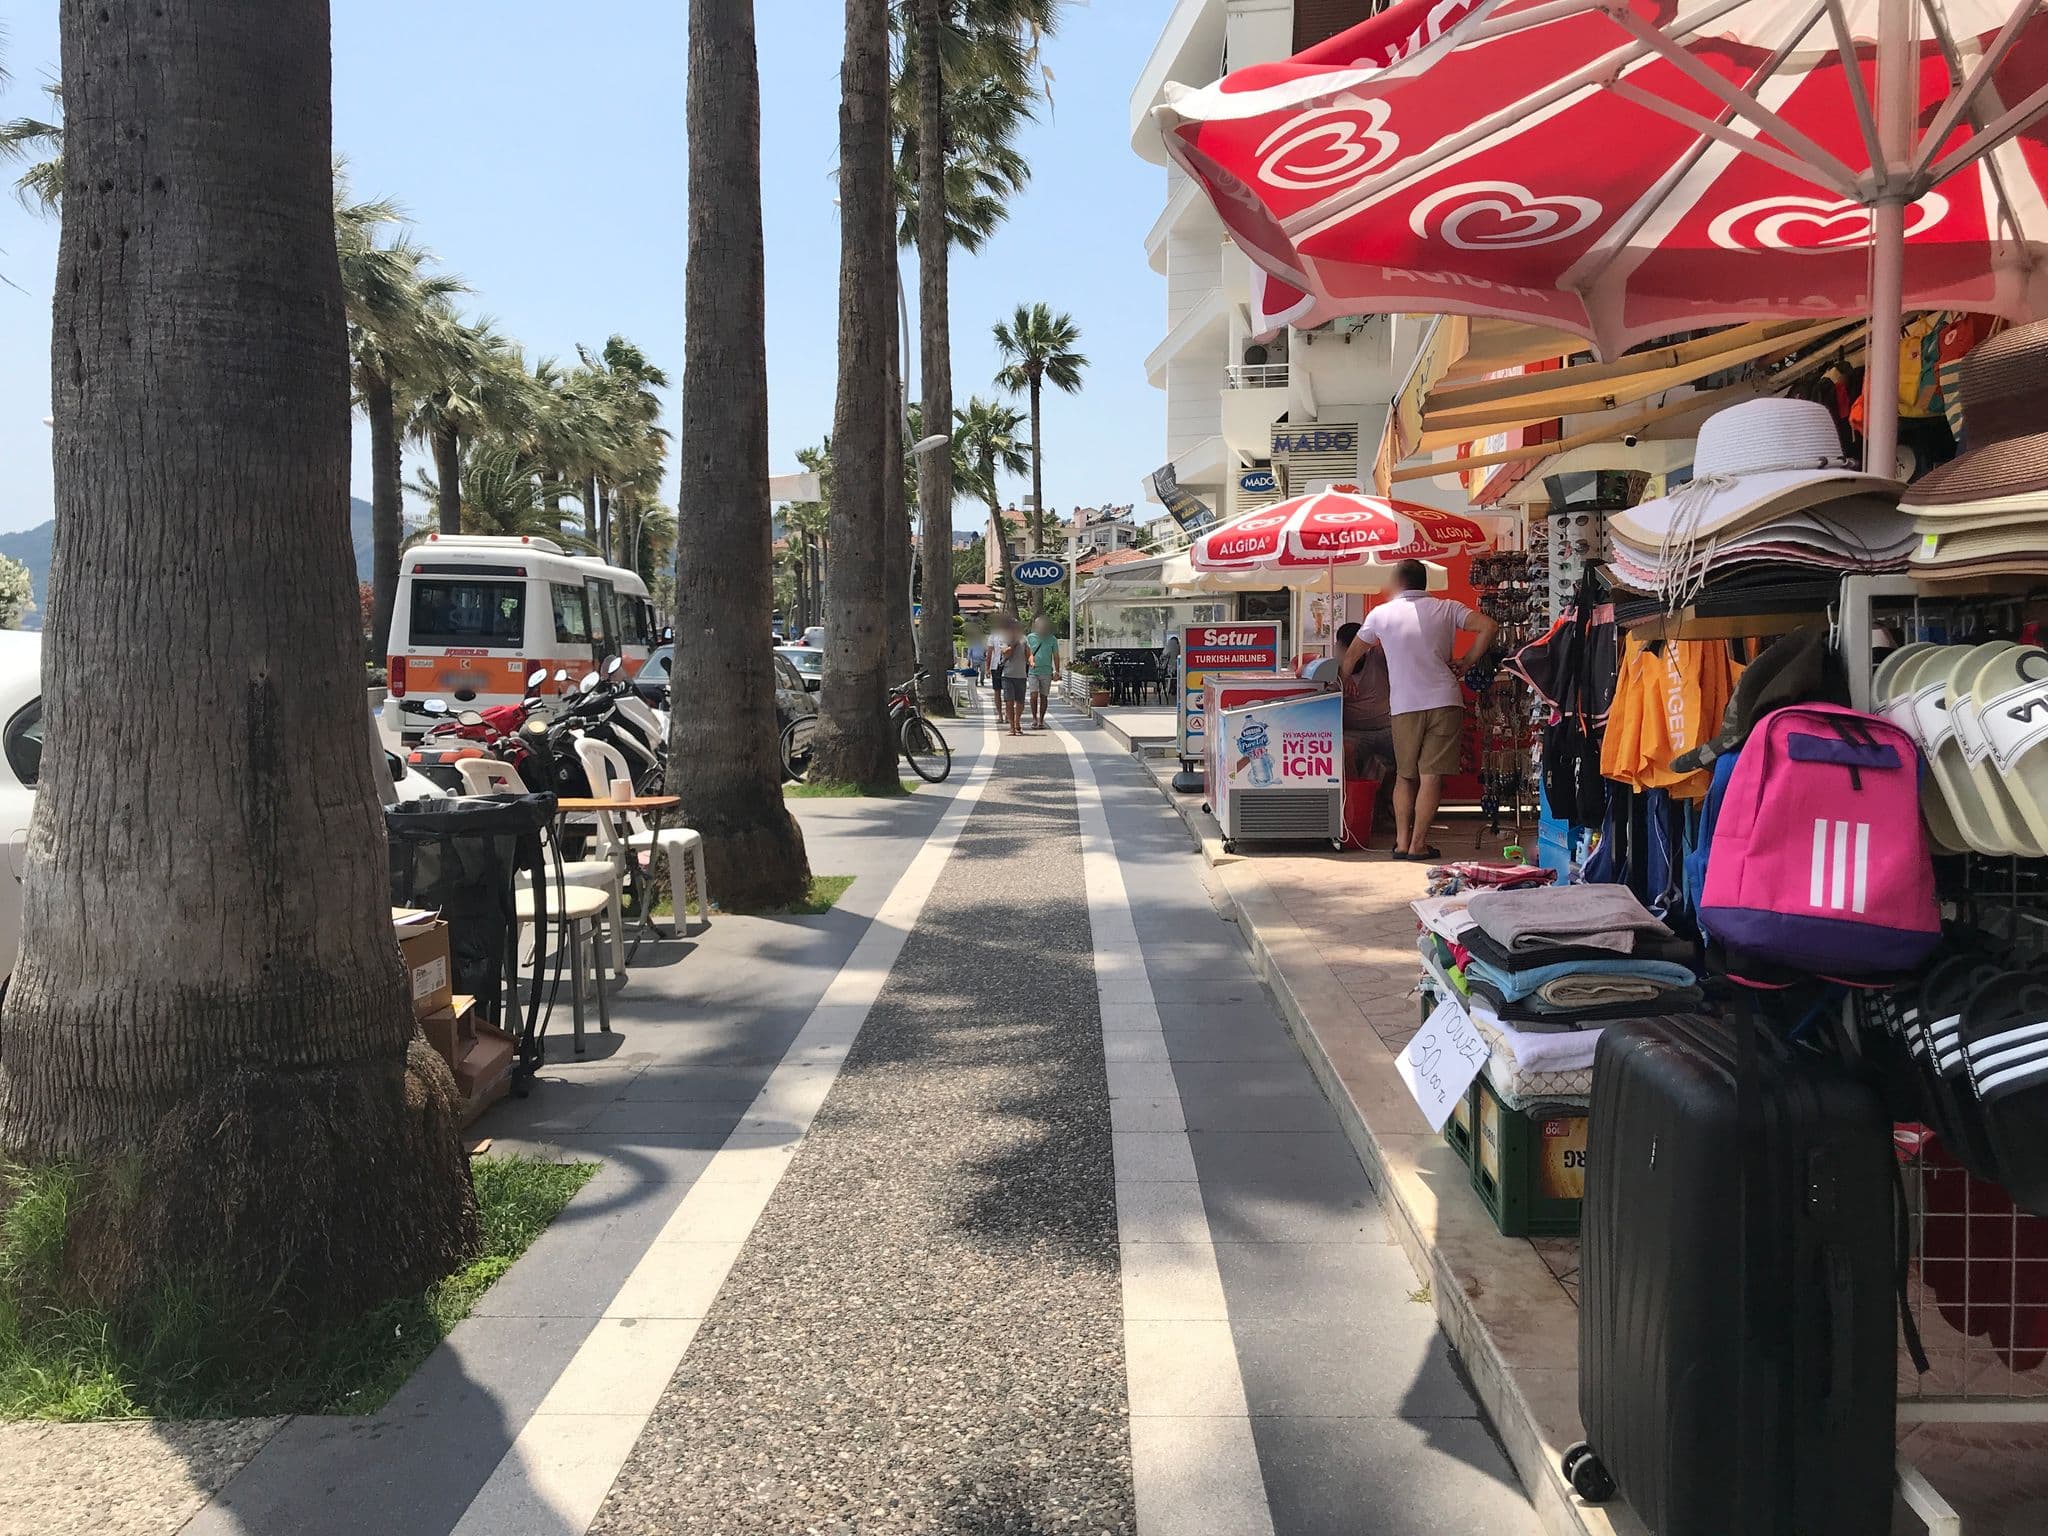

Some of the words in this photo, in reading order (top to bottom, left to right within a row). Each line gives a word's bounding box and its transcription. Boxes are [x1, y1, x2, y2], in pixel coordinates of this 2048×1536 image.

[1274, 431, 1352, 453] MADO
[1245, 476, 1274, 487] MADO
[1020, 566, 1059, 579] MADO
[1204, 628, 1257, 646] Setur
[1195, 655, 1230, 663] TURKISH
[1231, 654, 1266, 663] AIRLINES
[1308, 740, 1332, 754] SU
[1440, 1001, 1481, 1069] TOWEL
[1923, 1028, 1942, 1077] adidas
[1962, 1047, 1982, 1102] adidas
